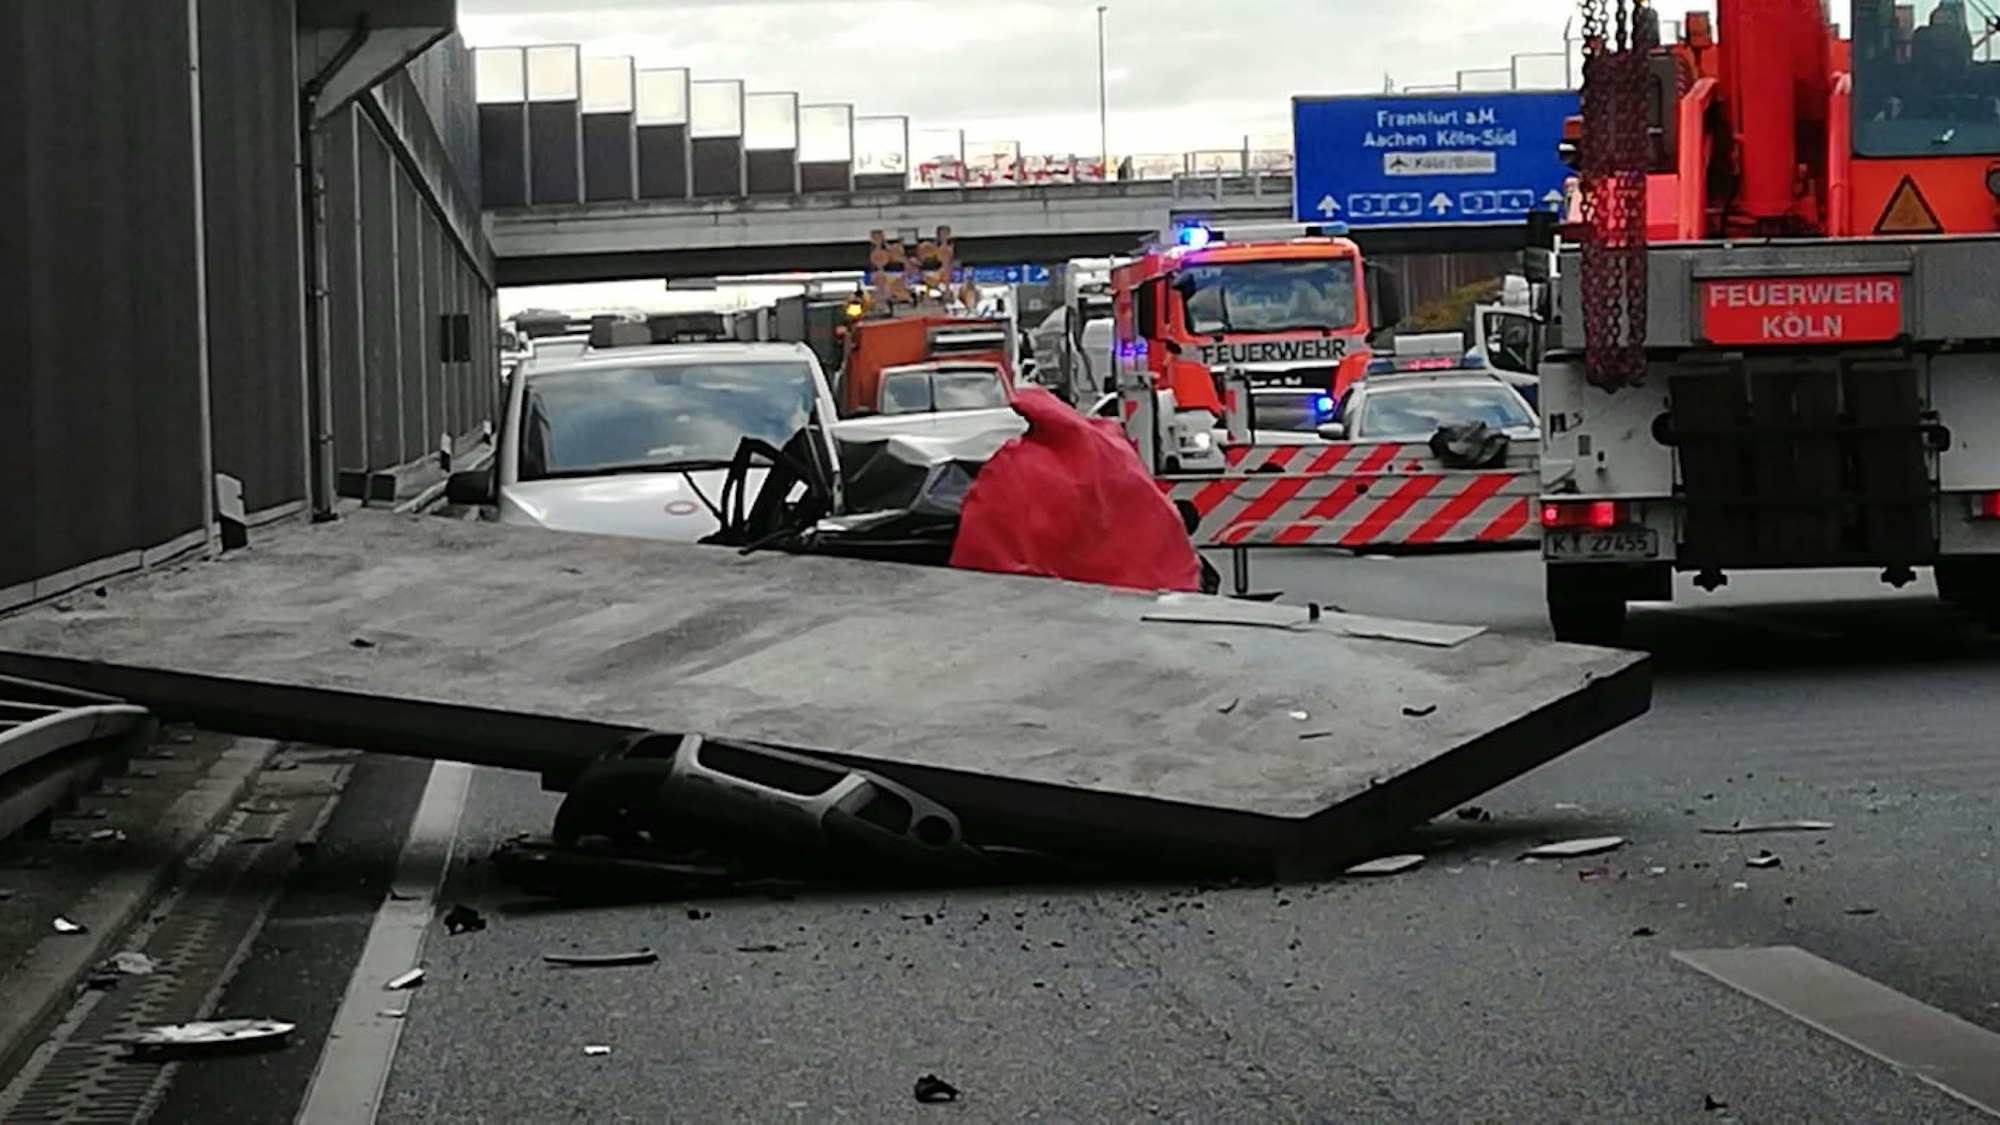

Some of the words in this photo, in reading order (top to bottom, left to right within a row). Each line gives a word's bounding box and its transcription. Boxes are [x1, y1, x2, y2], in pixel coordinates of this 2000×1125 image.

[1376, 110, 1459, 128] Frankfurt
[1362, 130, 1427, 148] Aachen
[1436, 128, 1518, 147] Köln-Süd
[1709, 280, 1896, 308] FEUERWEHR
[1761, 311, 1843, 339] KÖLN
[1201, 338, 1347, 364] FEUERWEHR
